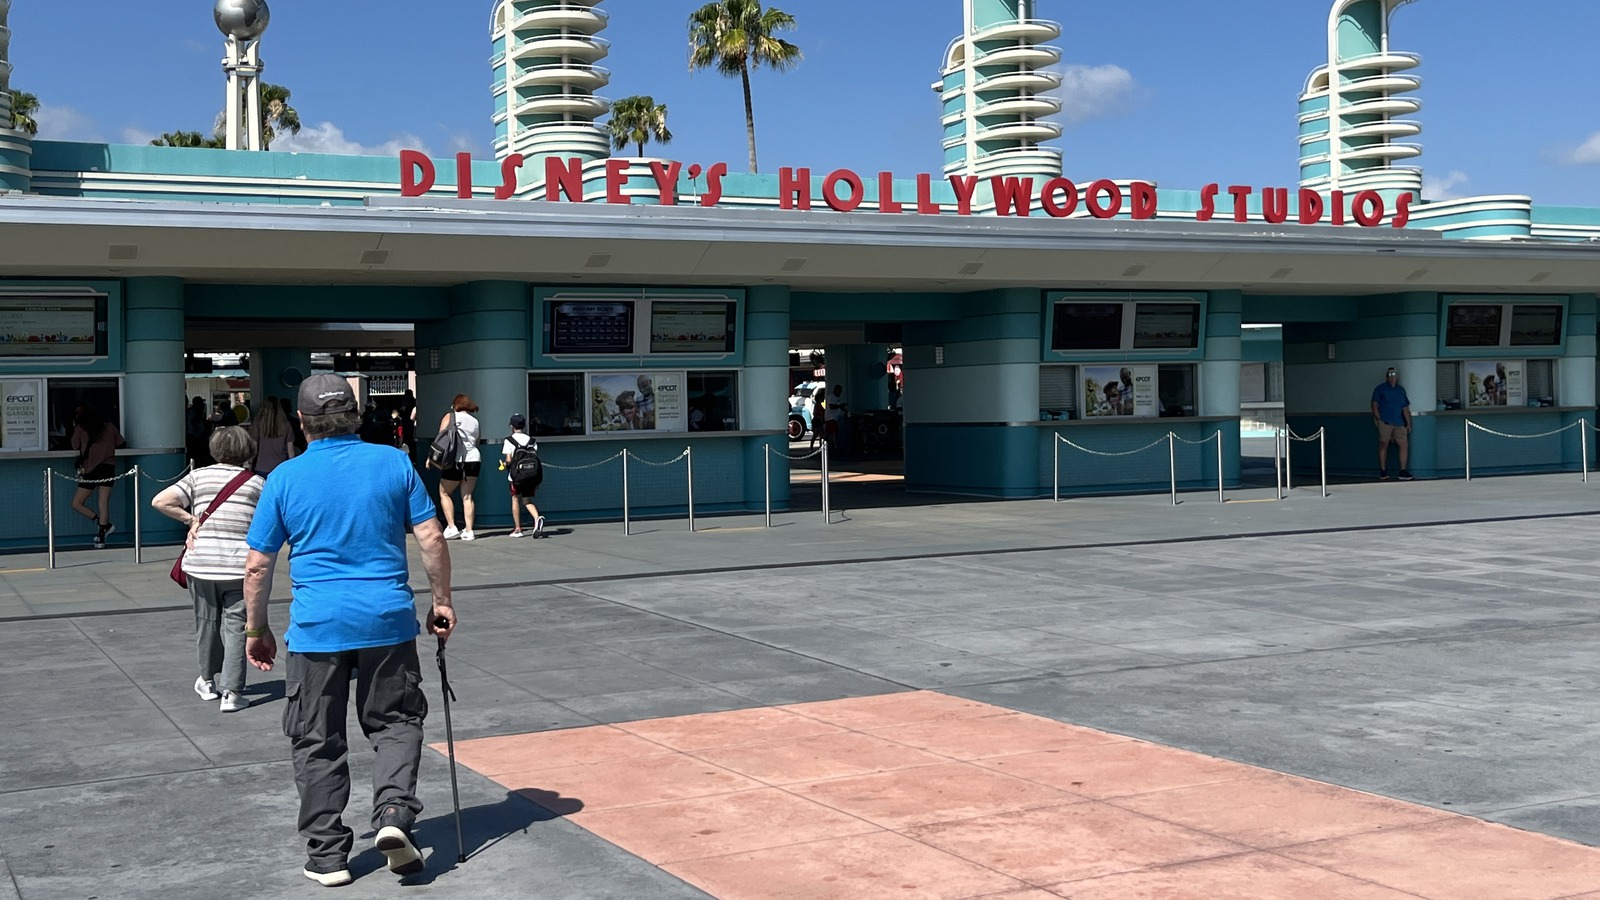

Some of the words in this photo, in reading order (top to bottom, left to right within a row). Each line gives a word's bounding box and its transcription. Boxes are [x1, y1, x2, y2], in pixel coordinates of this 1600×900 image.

[400, 150, 728, 207] DISNEY'S
[779, 167, 1158, 220] HOLLYWOOD
[1196, 183, 1413, 228] STUDIOS
